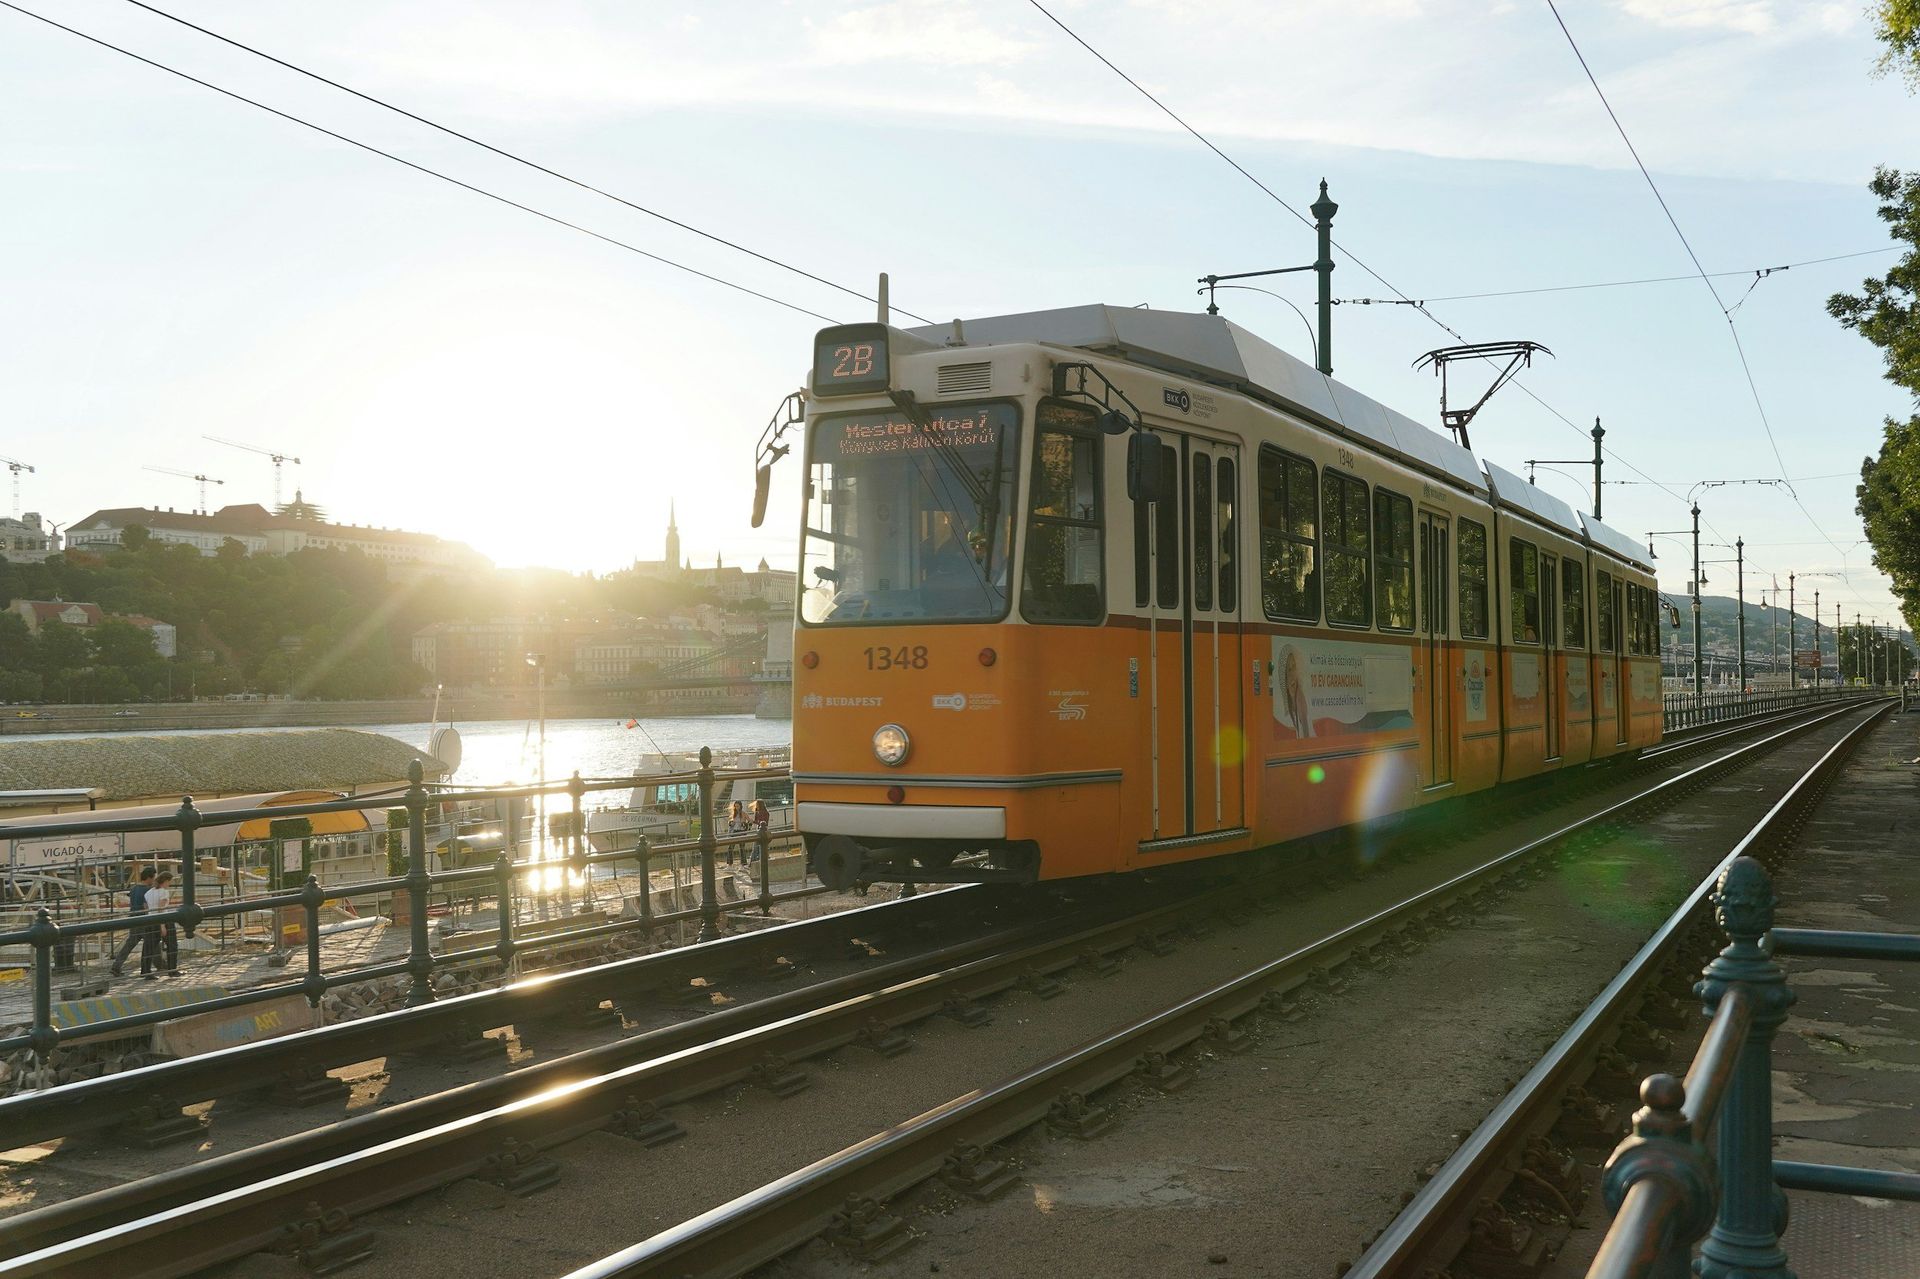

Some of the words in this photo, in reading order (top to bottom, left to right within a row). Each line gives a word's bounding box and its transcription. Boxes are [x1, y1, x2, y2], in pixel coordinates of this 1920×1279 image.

[833, 344, 873, 377] 2B
[1166, 394, 1179, 404] BKK
[845, 421, 916, 438] Mester
[1338, 449, 1354, 469] 1348
[864, 646, 928, 670] 1348
[826, 697, 883, 706] BUDAPEST
[43, 843, 84, 858] VIGADÓ
[87, 845, 96, 854] 4.
